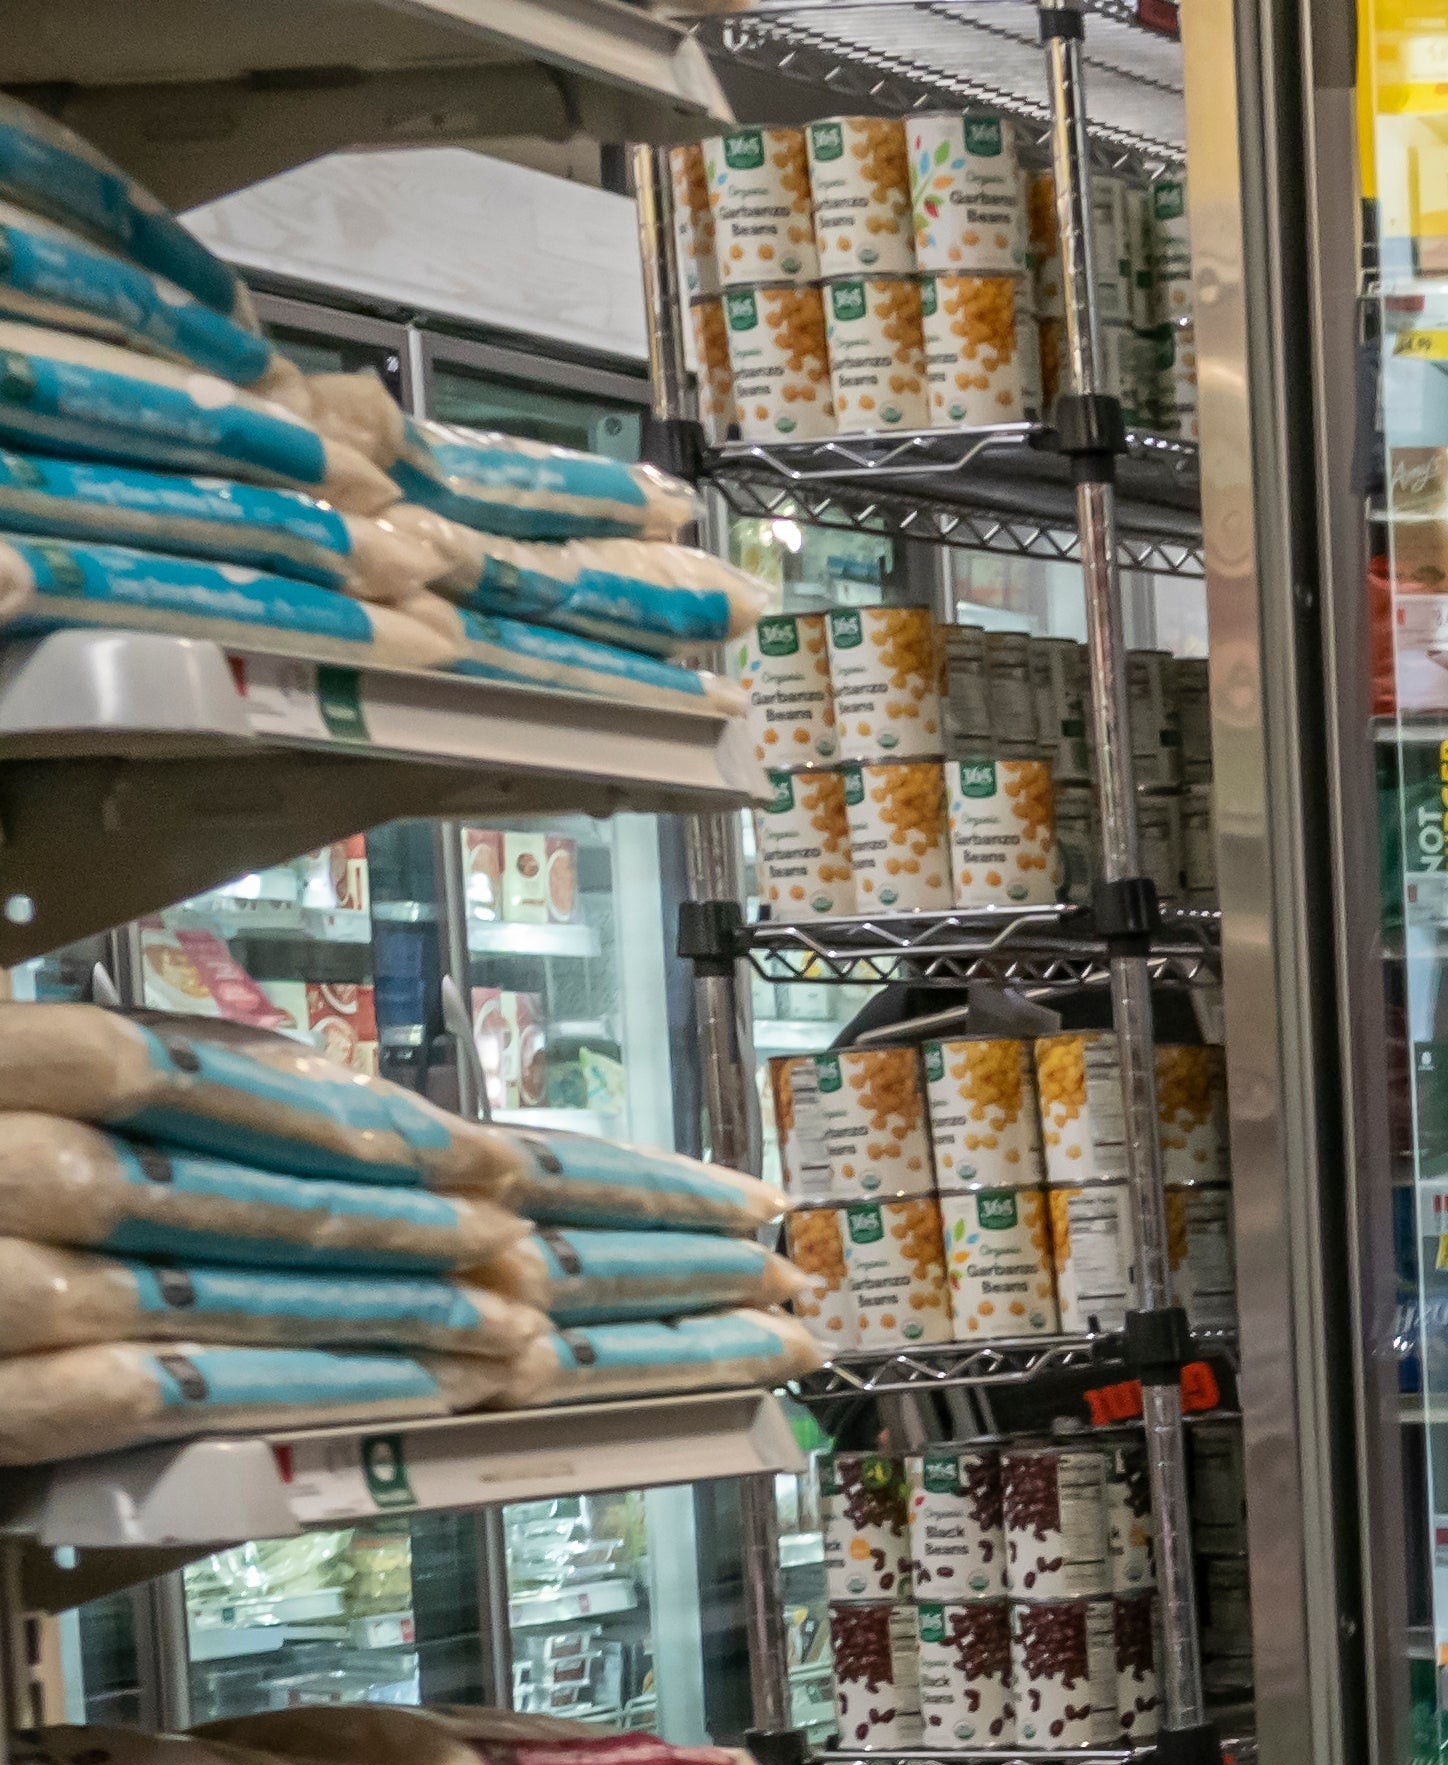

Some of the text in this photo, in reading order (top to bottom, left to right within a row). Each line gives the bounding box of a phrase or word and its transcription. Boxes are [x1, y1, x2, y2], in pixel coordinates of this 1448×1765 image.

[950, 191, 1018, 206] Garbanzo
[718, 205, 790, 219] Garbanzo
[731, 222, 778, 237] Beans
[762, 624, 795, 644] 365
[751, 691, 825, 705] Garbanzo
[766, 707, 813, 722] Beans
[1419, 806, 1444, 872] NOT
[967, 1263, 1038, 1278] Garbanzo
[982, 1279, 1028, 1294] Beans
[925, 1524, 965, 1539] Black
[924, 1541, 969, 1556] Beans
